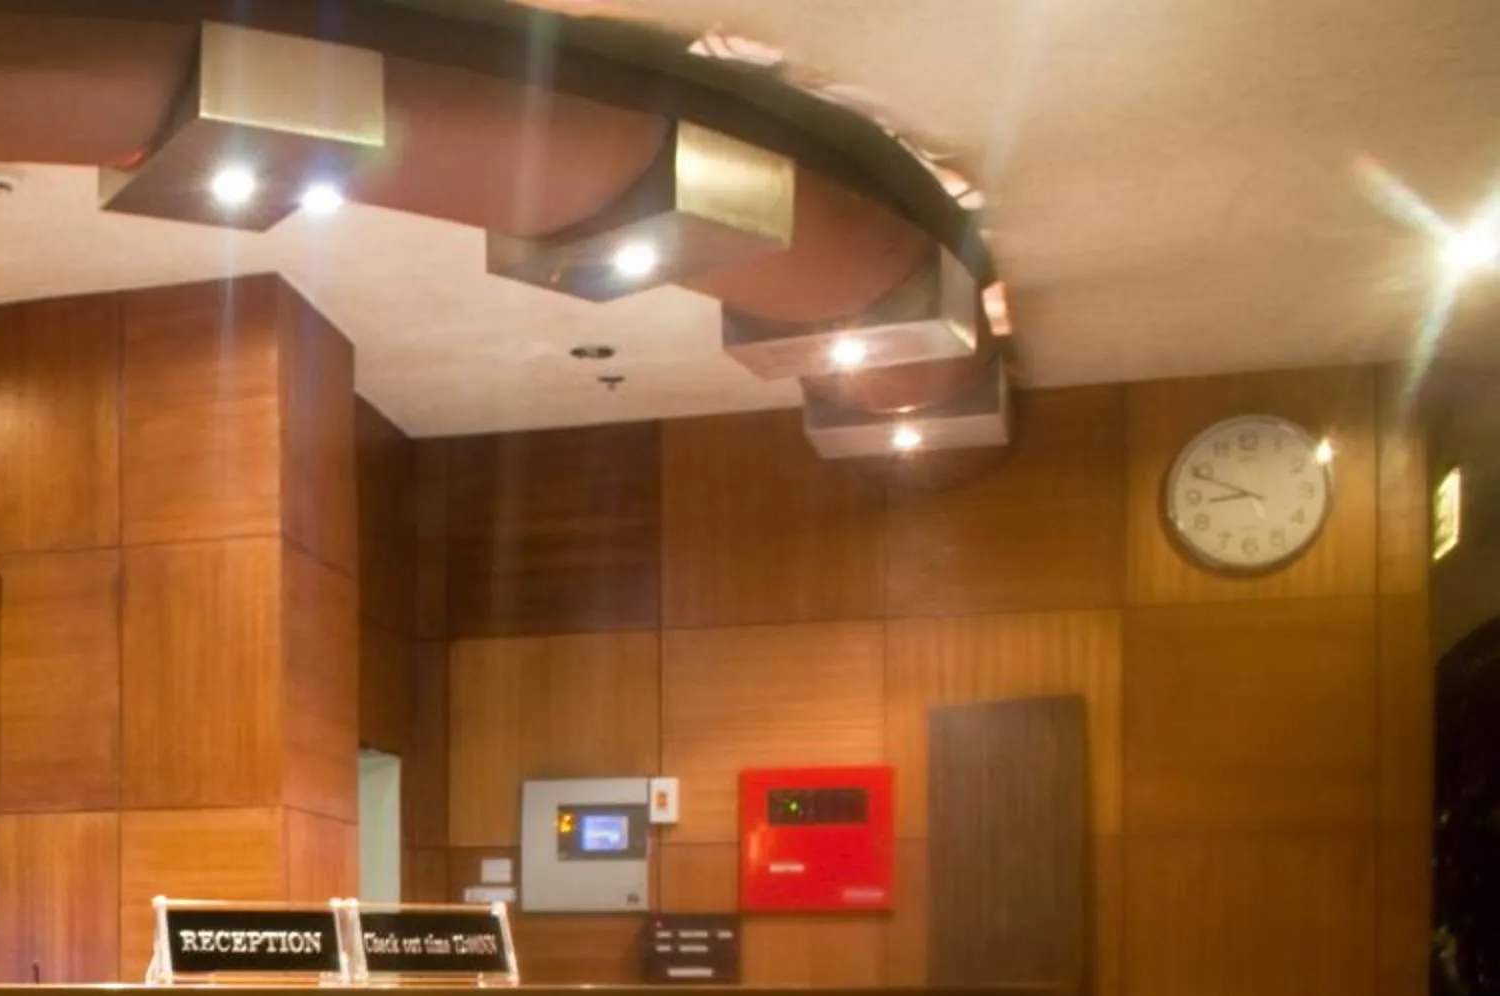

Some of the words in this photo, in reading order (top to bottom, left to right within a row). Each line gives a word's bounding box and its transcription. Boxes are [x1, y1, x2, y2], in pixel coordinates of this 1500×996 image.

[179, 929, 322, 953] RECEPTION
[363, 931, 400, 954] Check
[402, 937, 422, 954] out
[424, 932, 451, 954] time
